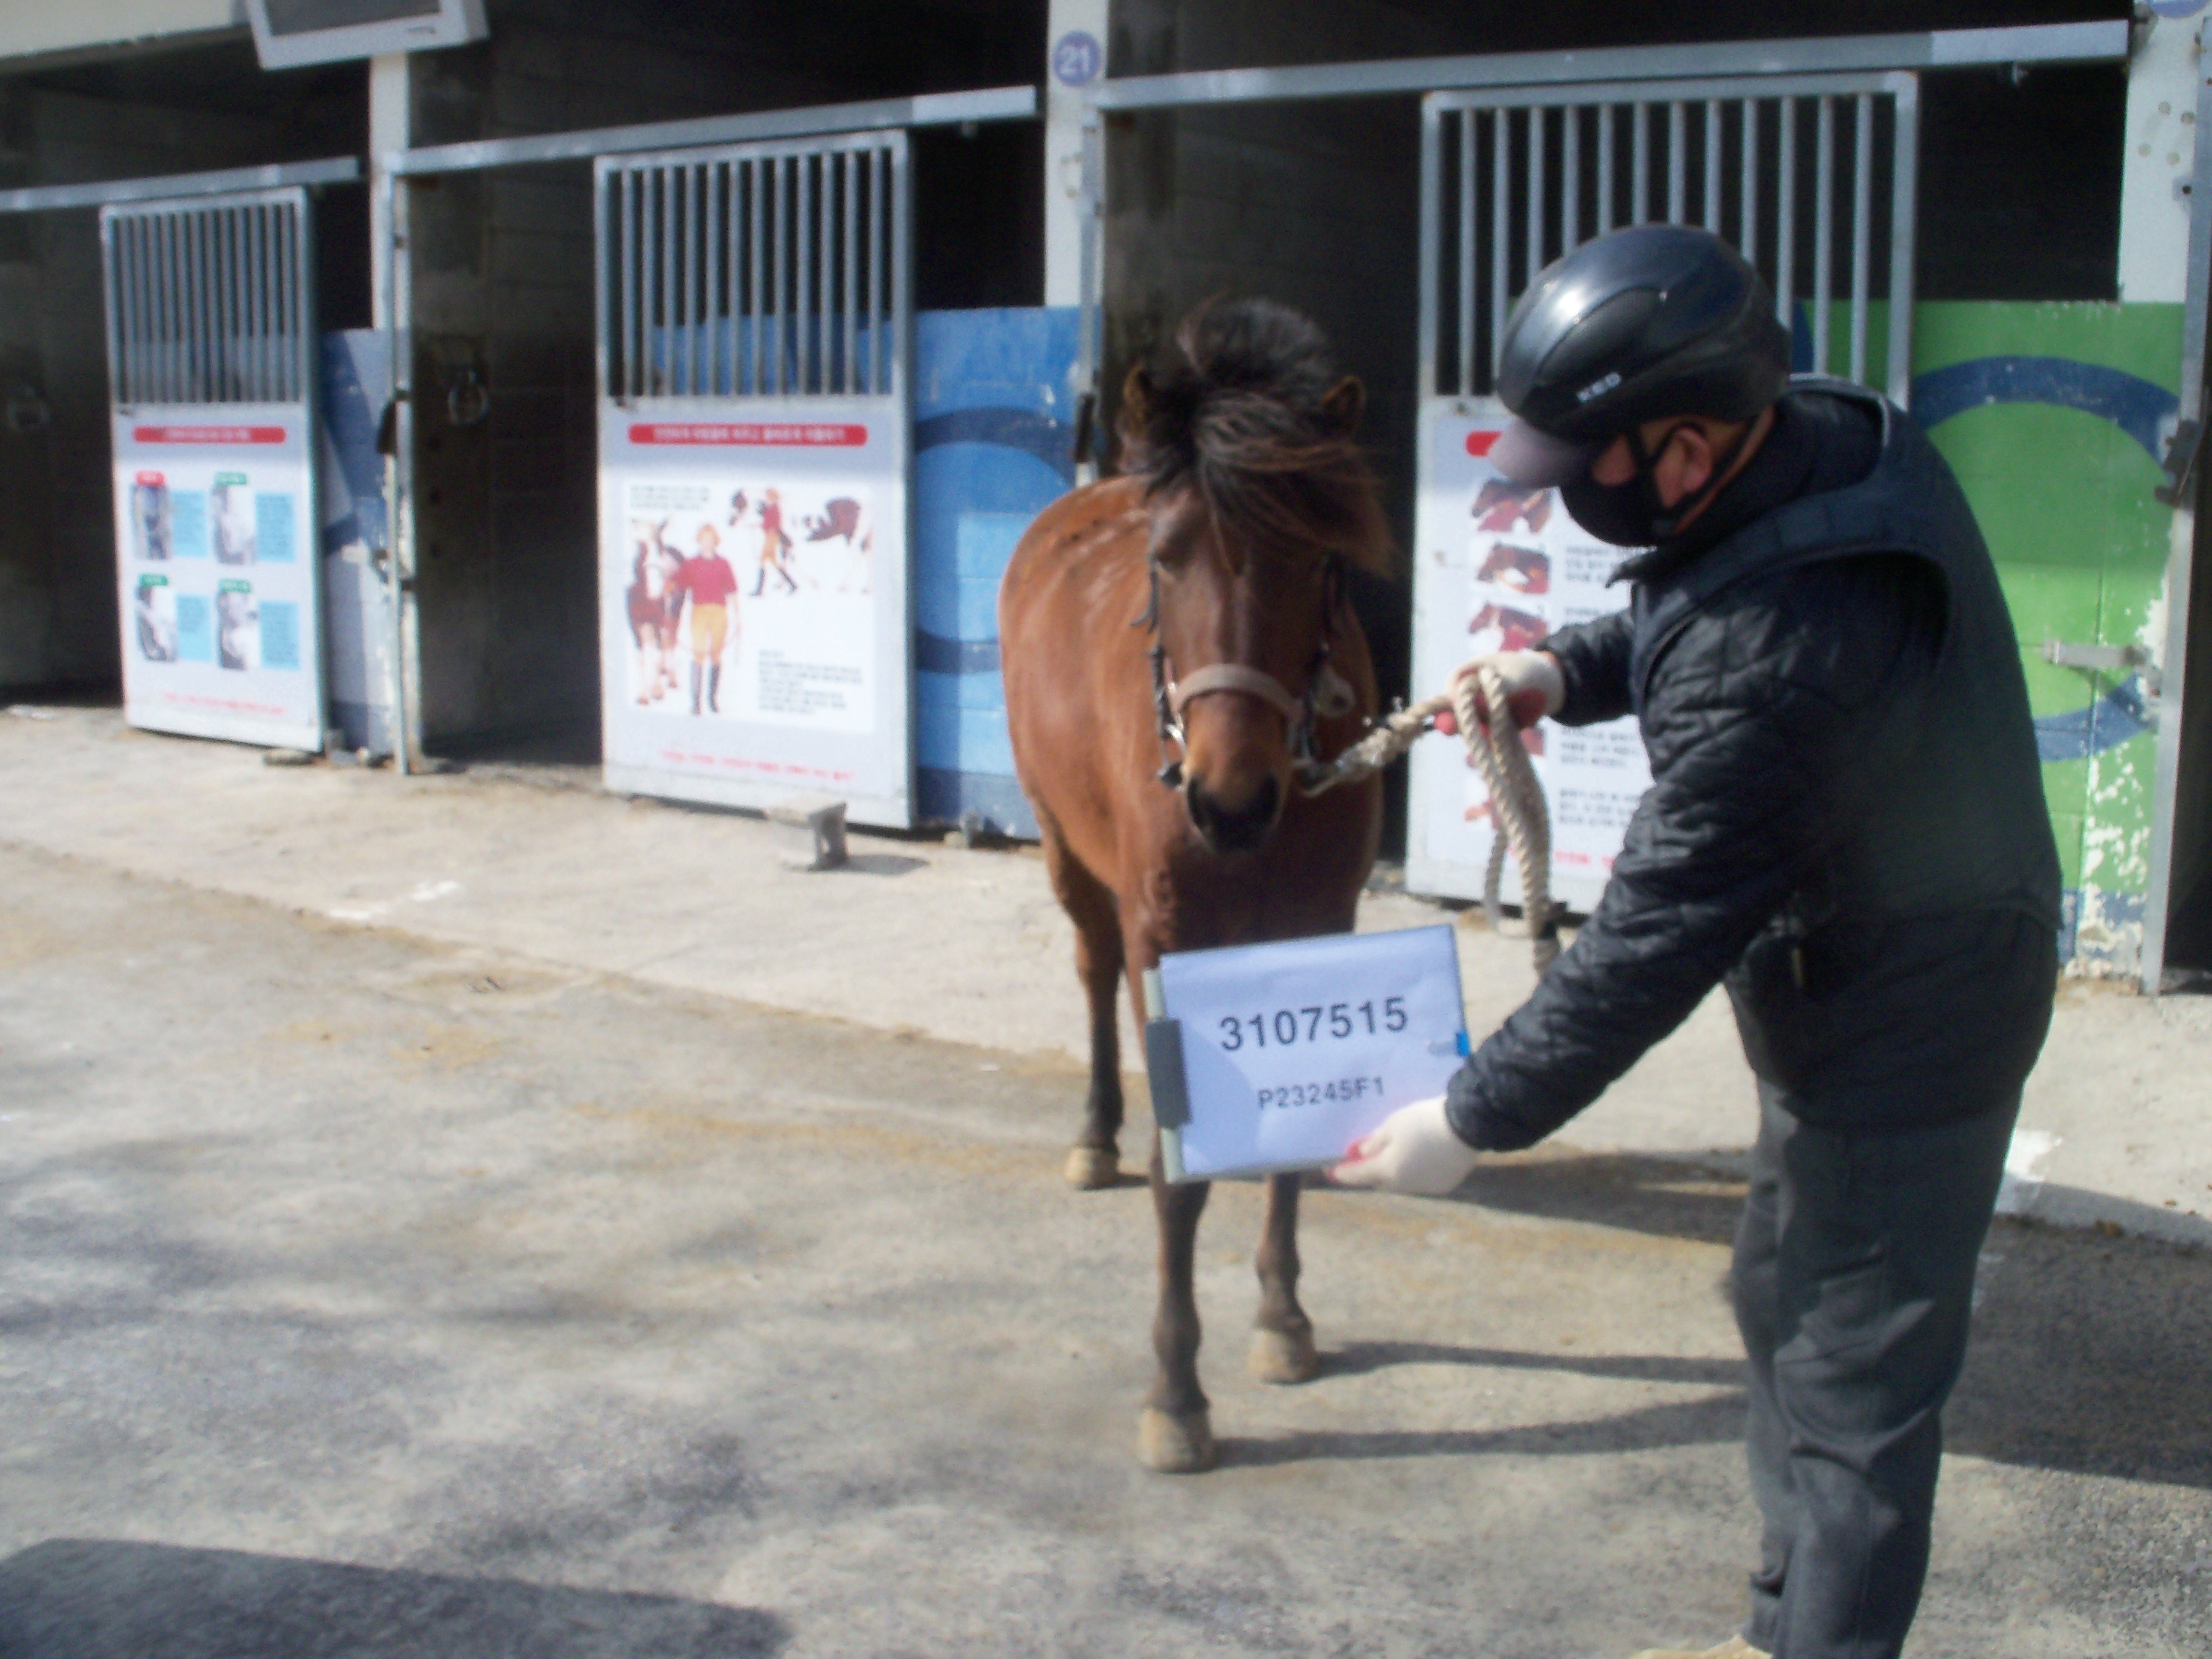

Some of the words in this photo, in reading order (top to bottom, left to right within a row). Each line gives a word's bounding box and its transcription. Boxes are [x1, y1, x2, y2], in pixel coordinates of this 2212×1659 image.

[1060, 45, 1090, 75] 21
[1220, 996, 1408, 1051] 3107515
[1258, 1076, 1384, 1110] P23245F1
